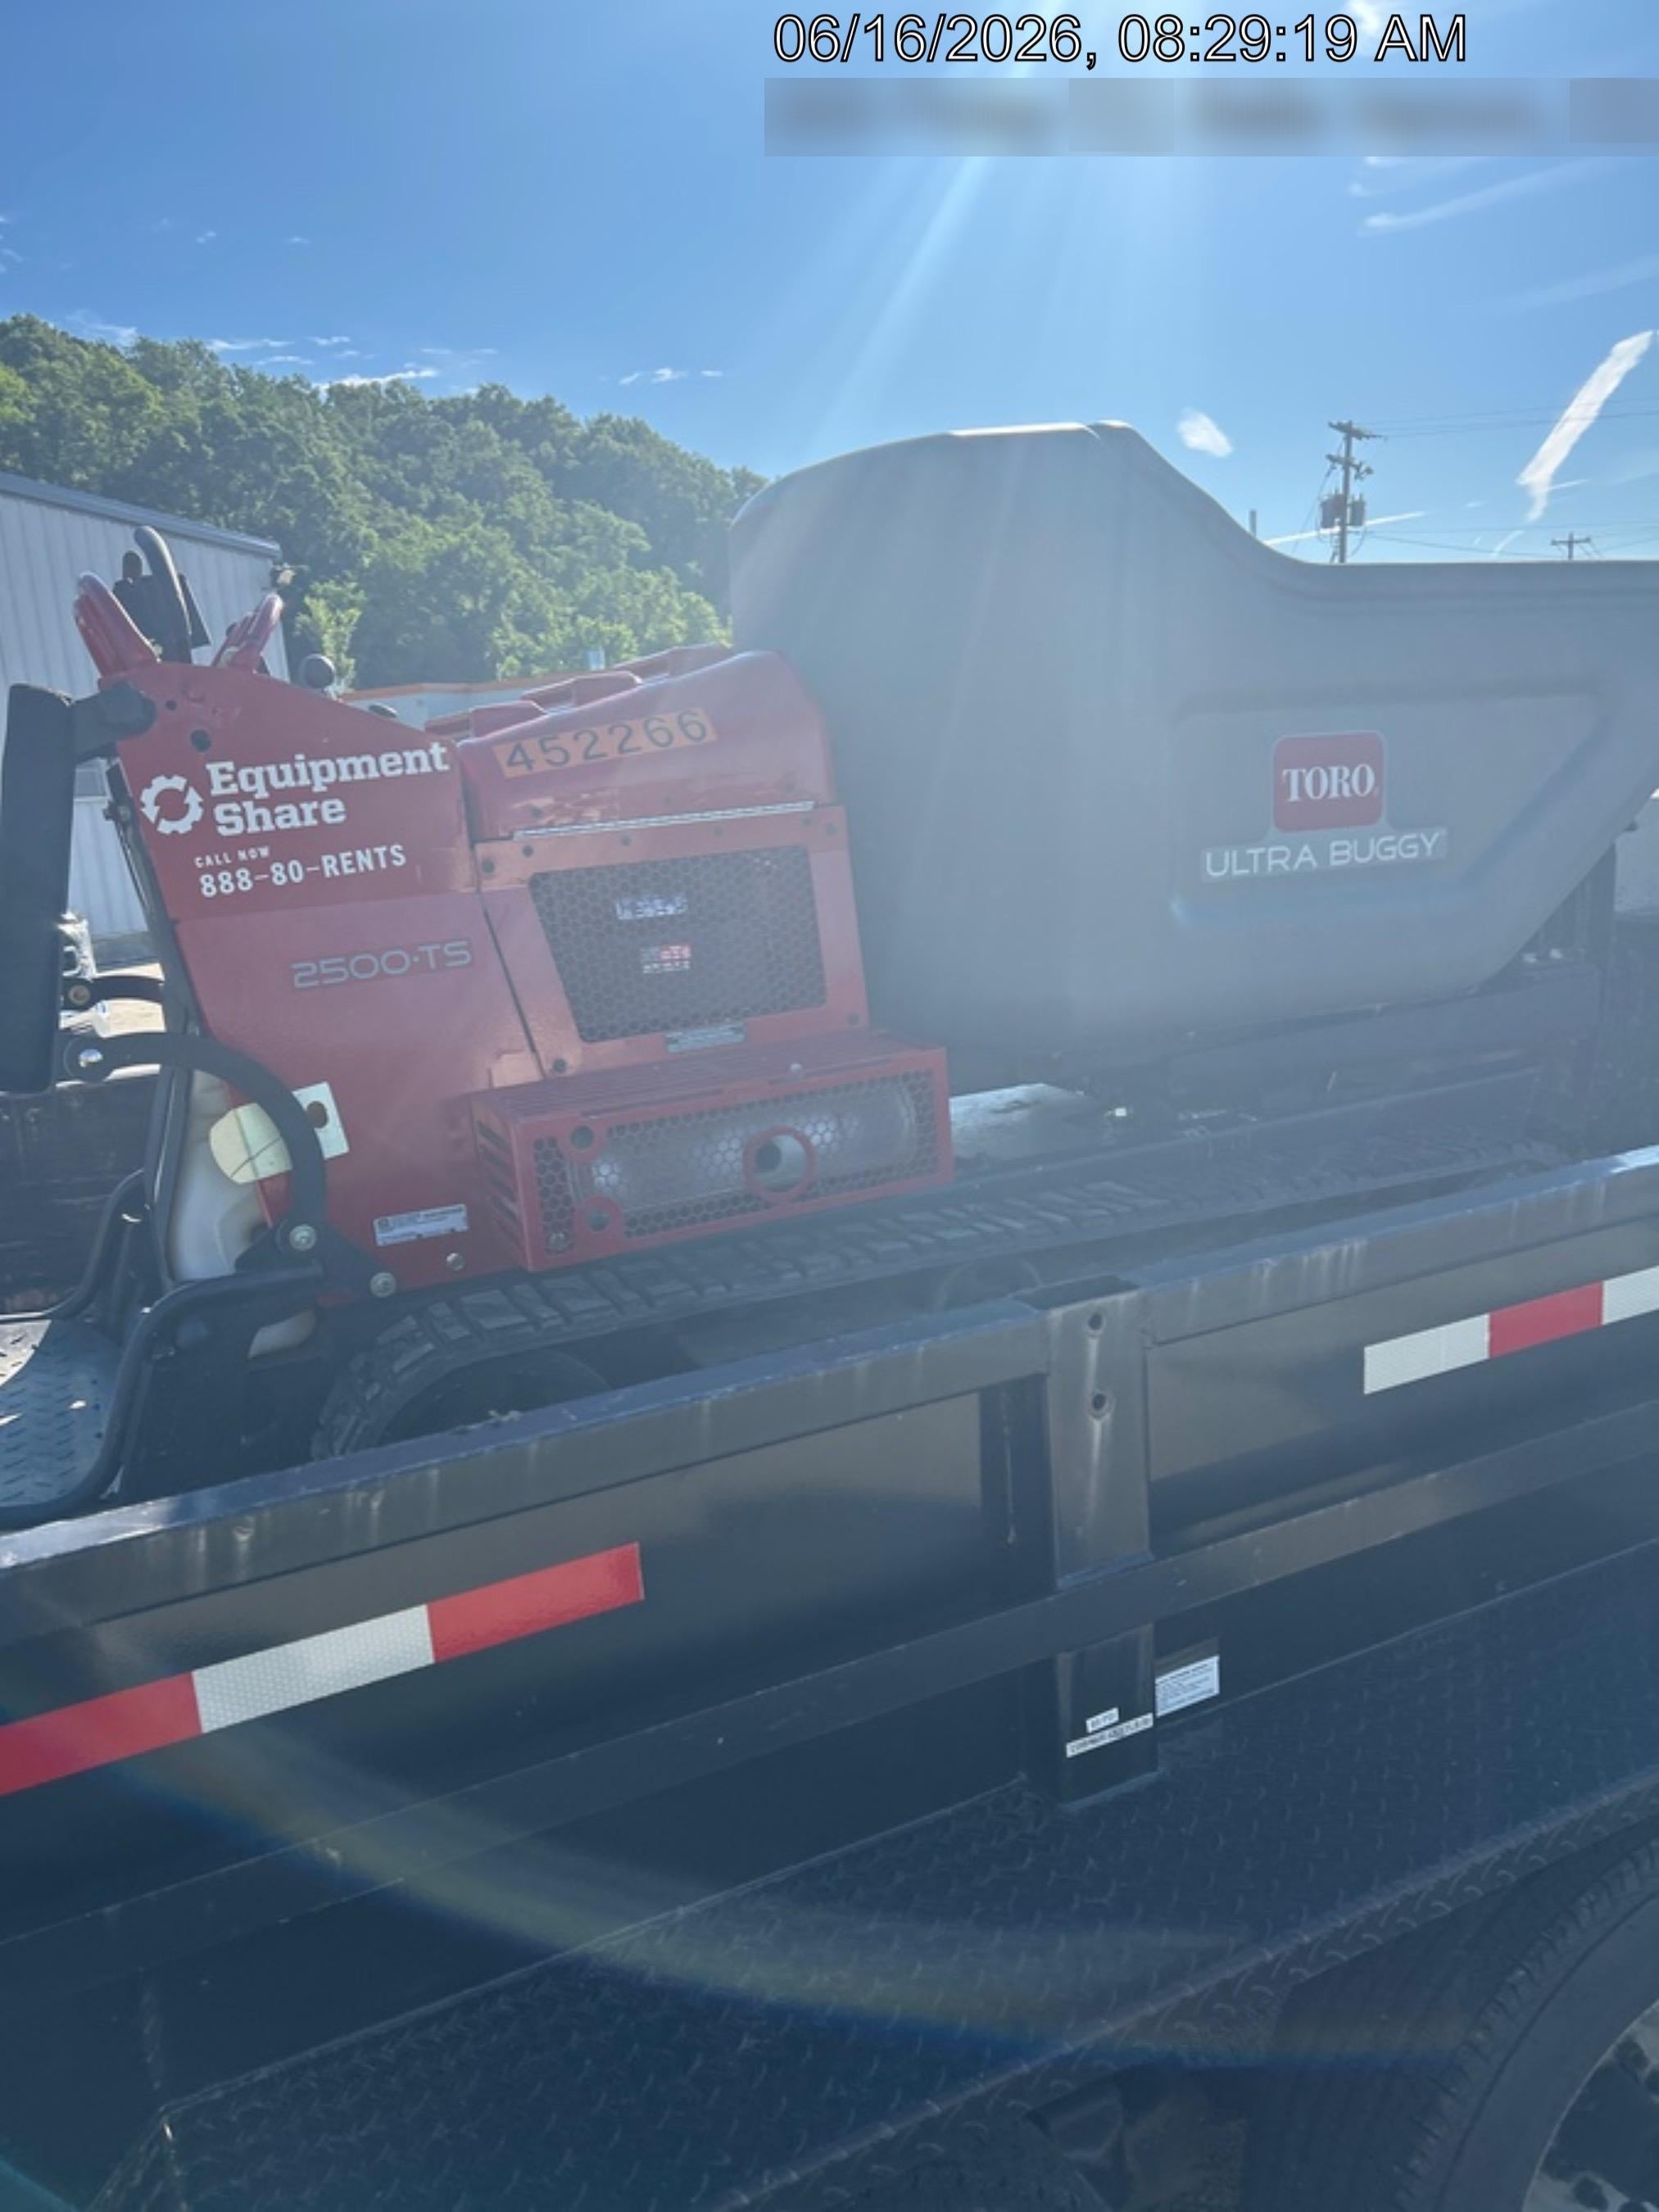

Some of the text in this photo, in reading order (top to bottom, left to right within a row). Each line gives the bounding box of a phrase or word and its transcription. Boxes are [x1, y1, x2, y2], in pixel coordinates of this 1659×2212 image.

[505, 708, 708, 773] 452266
[206, 741, 450, 798] Equipment
[1281, 763, 1376, 802] TORO
[213, 796, 347, 836] Share
[195, 846, 270, 869] CALL NOW
[199, 844, 406, 899] 888-80-RENTS
[1205, 831, 1439, 877] ULTRA BUGGY
